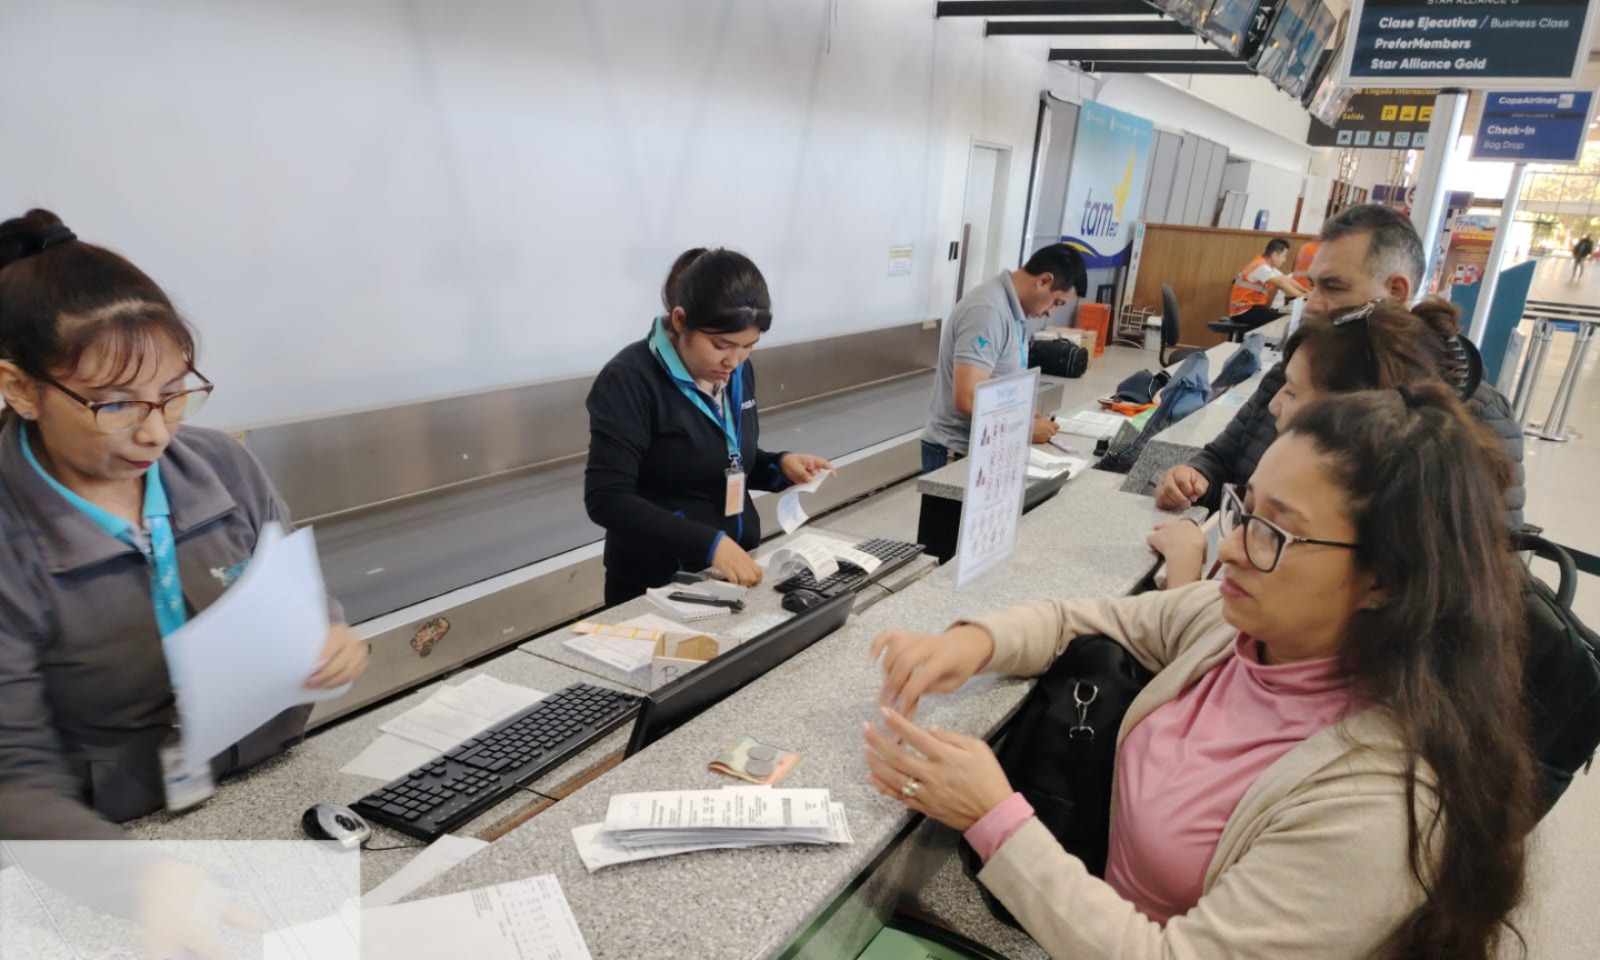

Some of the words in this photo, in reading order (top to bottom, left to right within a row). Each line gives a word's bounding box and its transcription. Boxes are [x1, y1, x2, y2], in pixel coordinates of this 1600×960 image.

[1378, 17, 1415, 29] Clase
[1417, 16, 1478, 31] Ejecutiva
[1490, 18, 1536, 28] Business
[1538, 17, 1570, 29] Class
[1374, 37, 1471, 49] PreferMembers
[1370, 58, 1398, 70] Star
[1399, 57, 1451, 70] Alliance
[1454, 58, 1487, 70] Gold
[1498, 96, 1558, 106] CopaAirlines
[1342, 112, 1365, 121] Salida
[1487, 125, 1535, 136] Check-In
[1483, 140, 1501, 150] Bag
[1502, 141, 1524, 150] Drop
